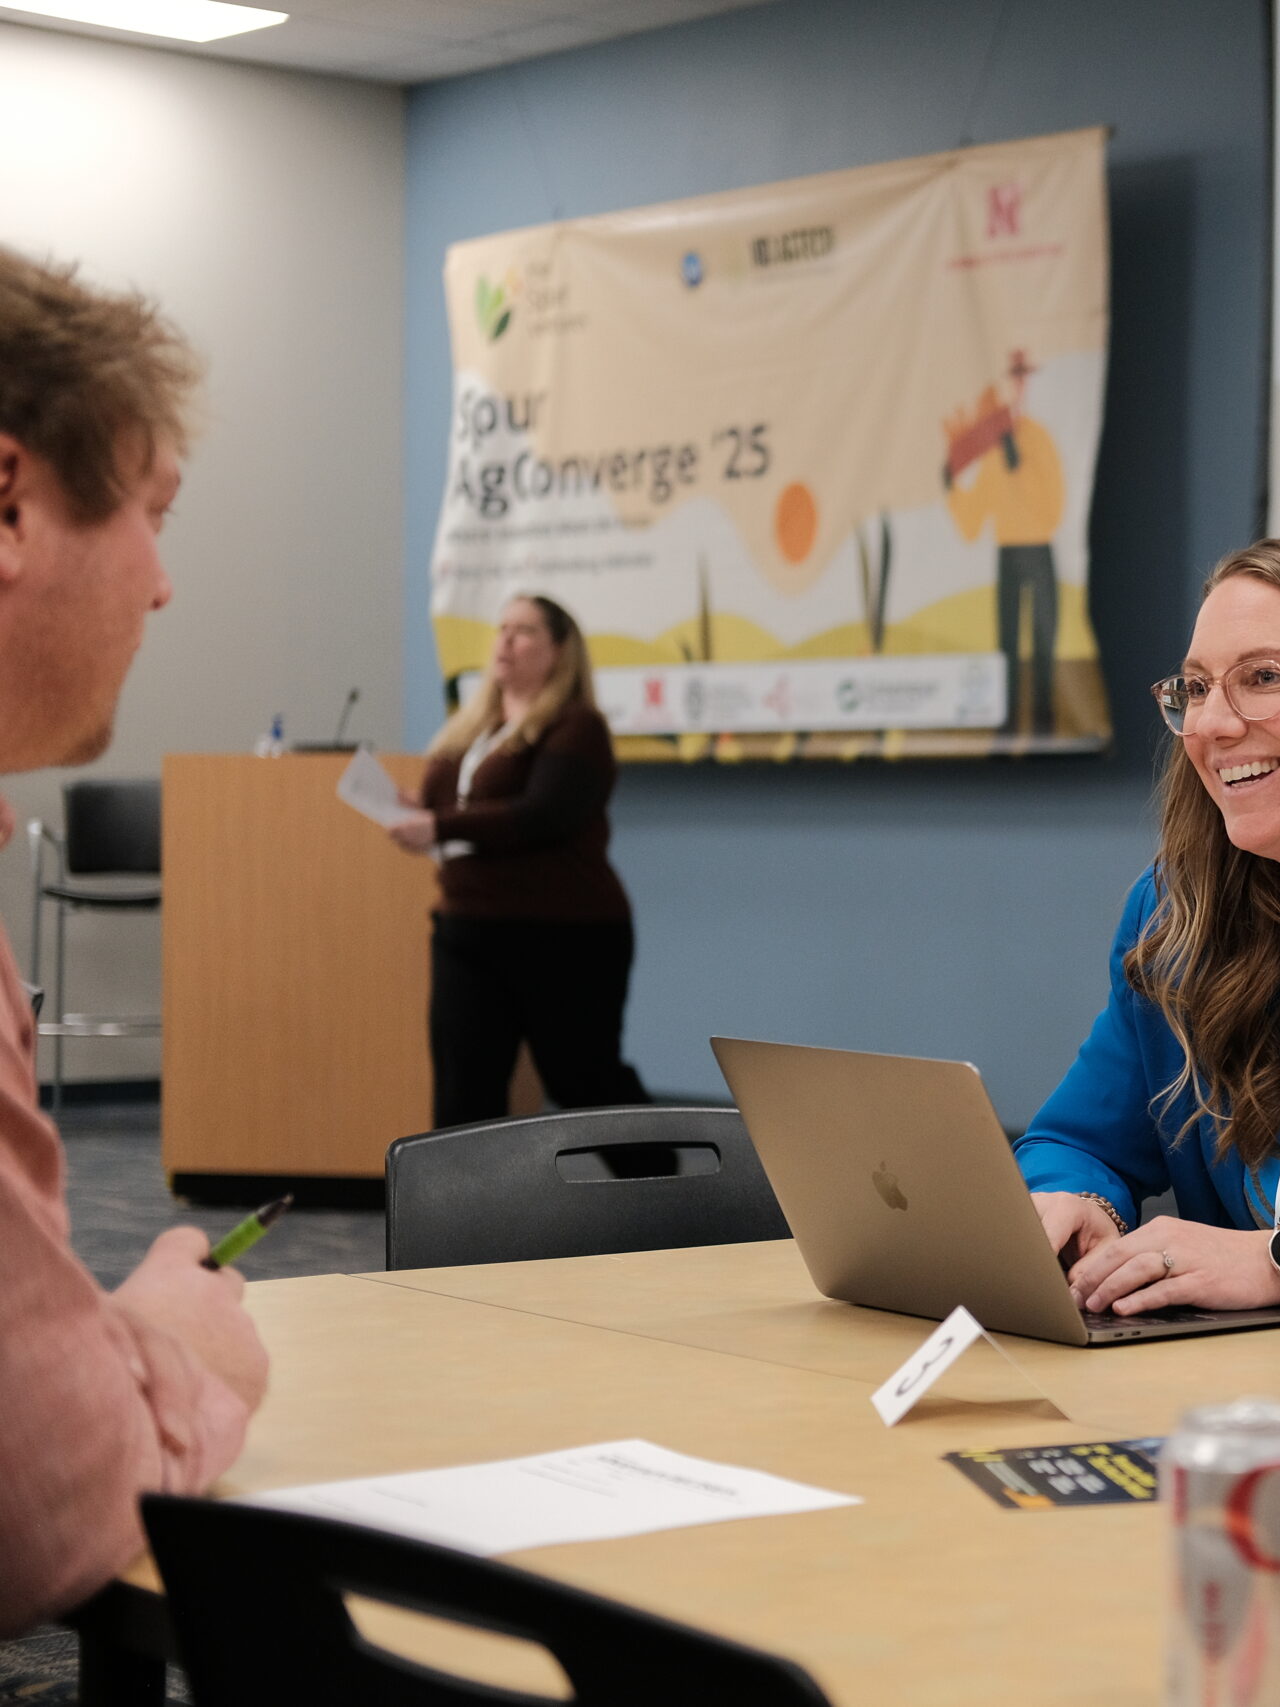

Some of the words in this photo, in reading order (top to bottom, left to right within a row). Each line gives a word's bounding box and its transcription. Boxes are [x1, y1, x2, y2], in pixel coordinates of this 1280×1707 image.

[456, 389, 546, 450] Spur
[455, 444, 698, 518] AgConverge
[712, 422, 771, 480] '25
